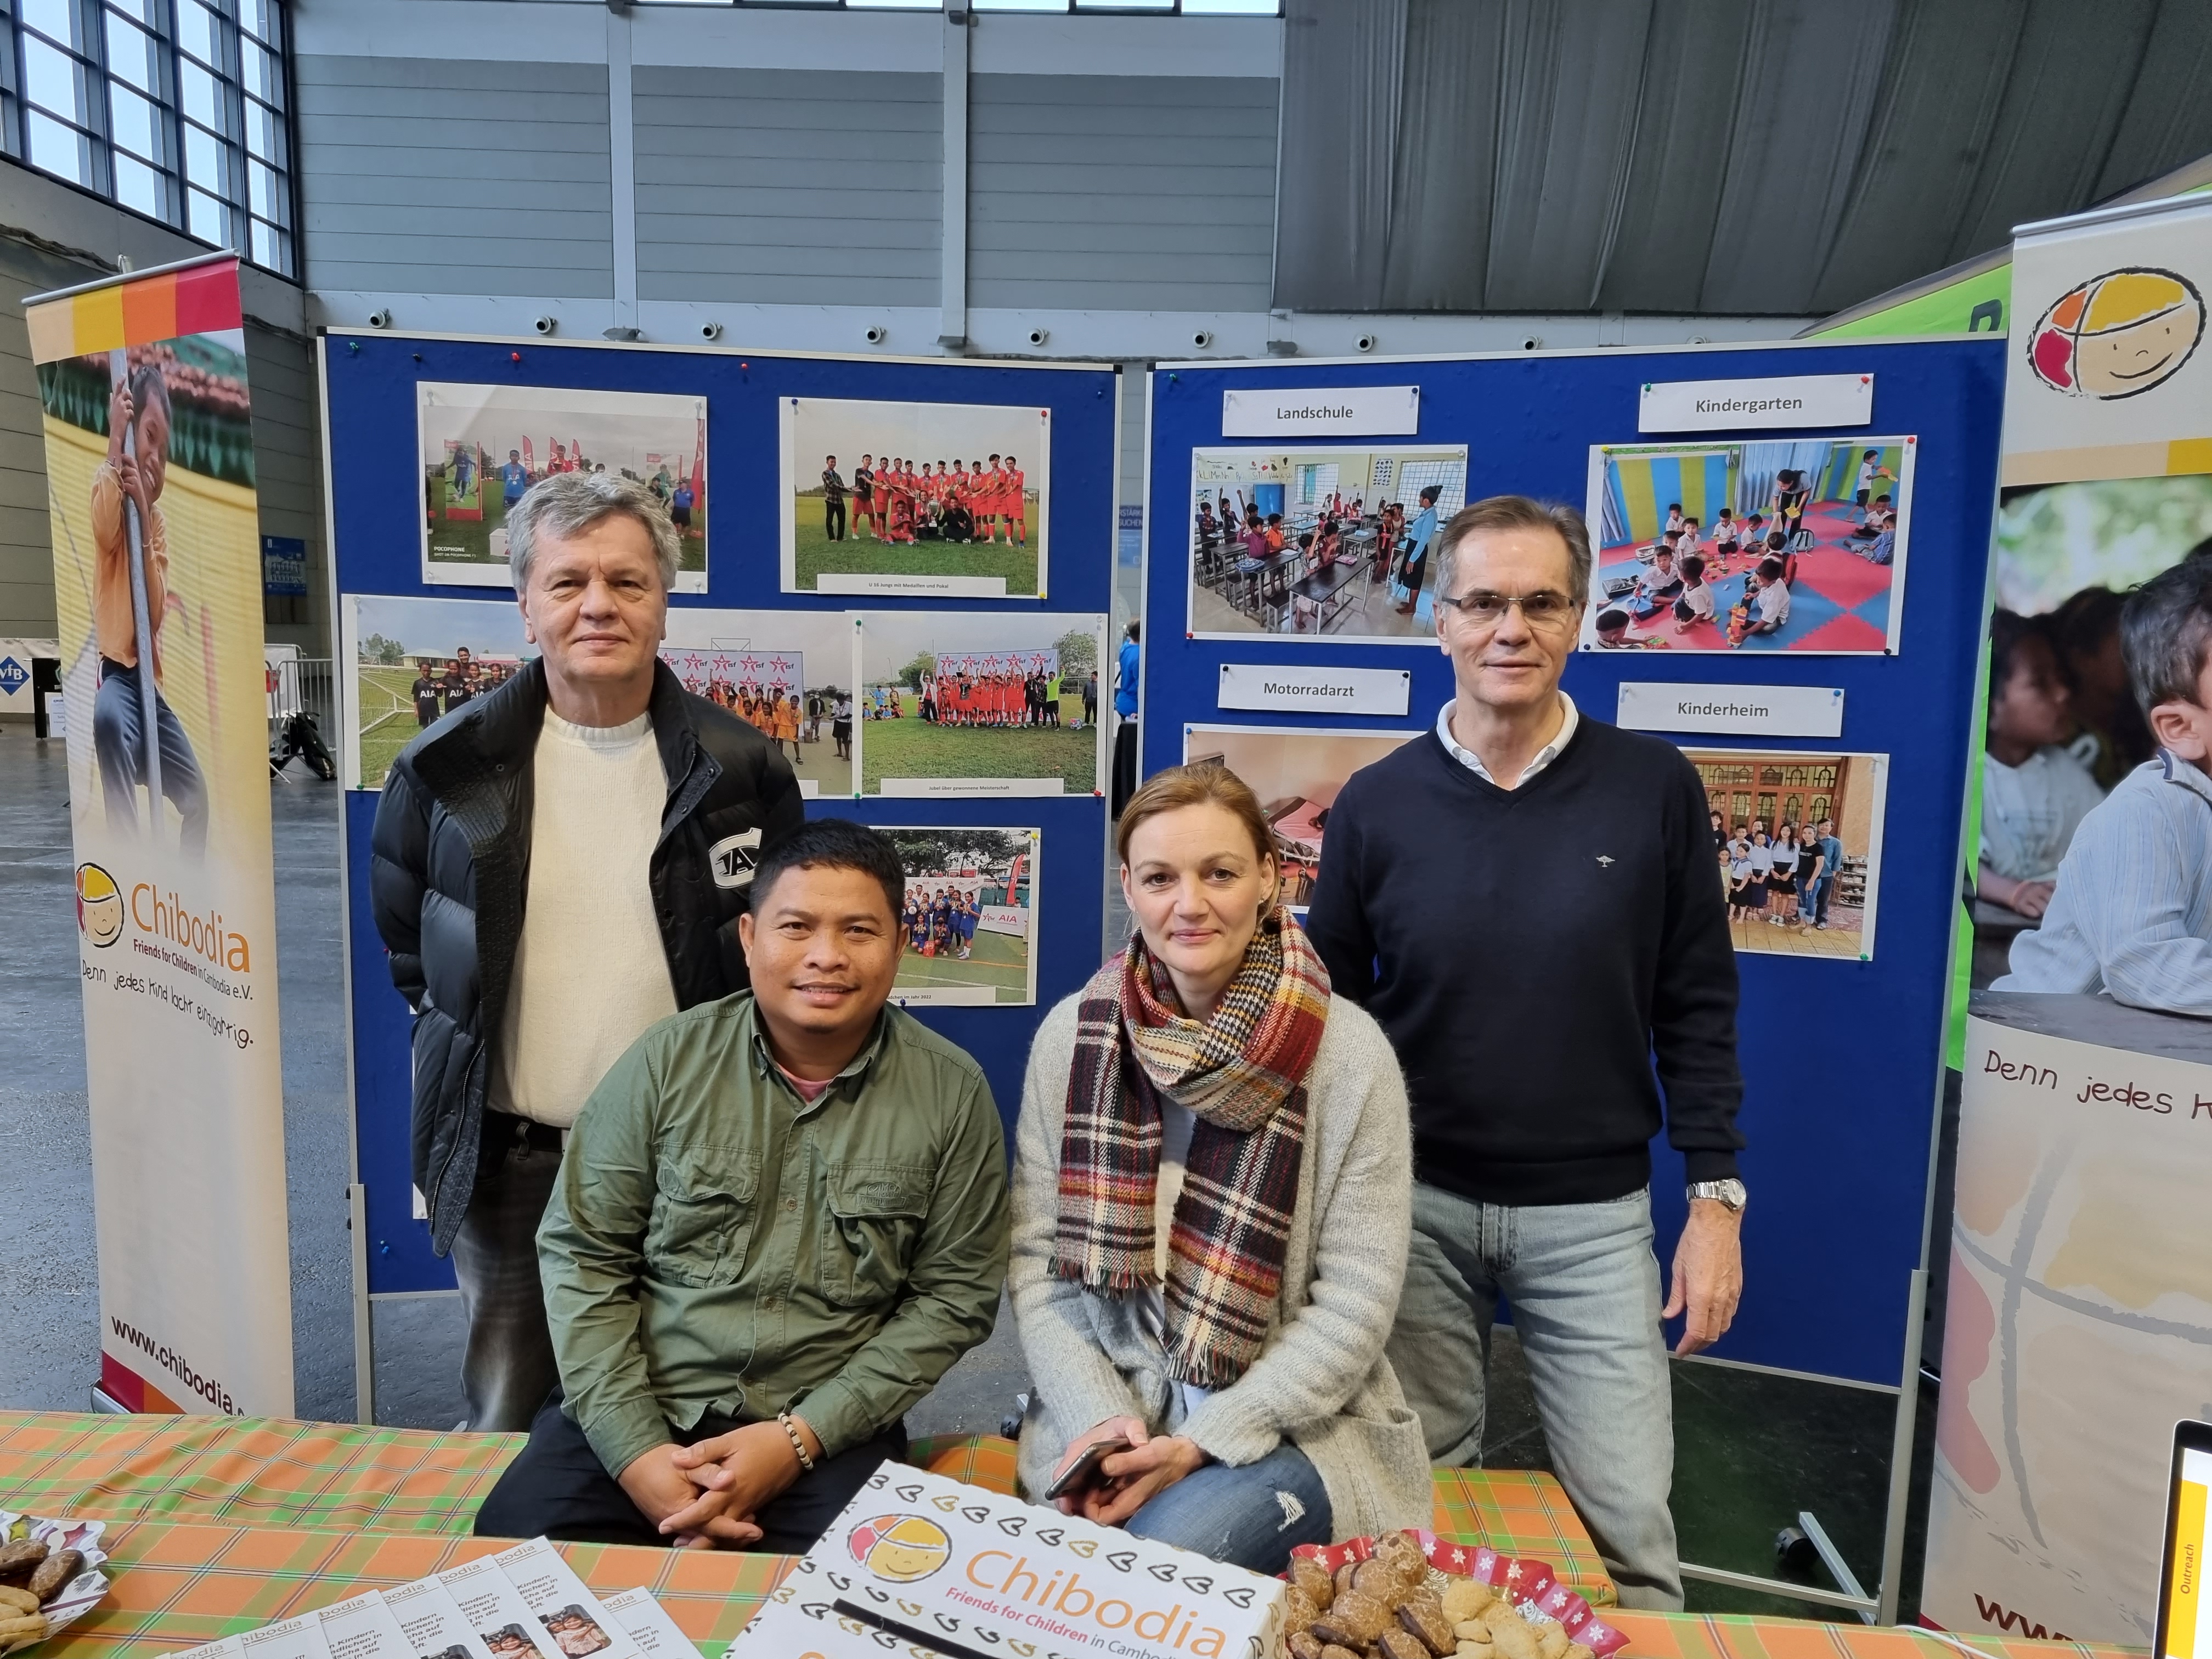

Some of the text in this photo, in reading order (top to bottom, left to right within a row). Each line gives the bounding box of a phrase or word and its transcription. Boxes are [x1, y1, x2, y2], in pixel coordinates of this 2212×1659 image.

[1277, 405, 1353, 419] Landschule
[1696, 398, 1802, 413] Kindergarten
[1263, 682, 1355, 697] Motorradarzt
[1678, 702, 1769, 716] Kinderheim
[998, 915, 1017, 923] AIA
[132, 883, 250, 973] Chibodia
[133, 939, 253, 1000] Friends for Children in Cambodia e.V.
[82, 959, 106, 983] Denn
[114, 971, 145, 994] jedes
[171, 985, 194, 1014] lacht
[197, 1005, 253, 1049] einzigartig.
[1984, 1049, 2058, 1090] Denn
[2077, 1076, 2173, 1114] jedes
[111, 1316, 245, 1416] www.chibodia.
[2180, 1544, 2194, 1594] Outreach
[517, 1575, 550, 1589] Kindern
[542, 1585, 555, 1593] auf
[458, 1593, 493, 1607] Kindern
[482, 1603, 496, 1611] auf
[966, 1550, 1227, 1659] Chibodia
[401, 1613, 437, 1629] Kindern
[945, 1587, 1000, 1614] Friends
[1001, 1604, 1024, 1621] for
[1025, 1615, 1089, 1644] Children
[1090, 1634, 1105, 1649] in
[425, 1623, 440, 1632] auf
[429, 1629, 443, 1638] die
[338, 1629, 375, 1645] Kindern
[642, 1637, 656, 1646] auf
[362, 1640, 377, 1650] auf
[365, 1647, 380, 1655] die
[647, 1643, 660, 1651] die
